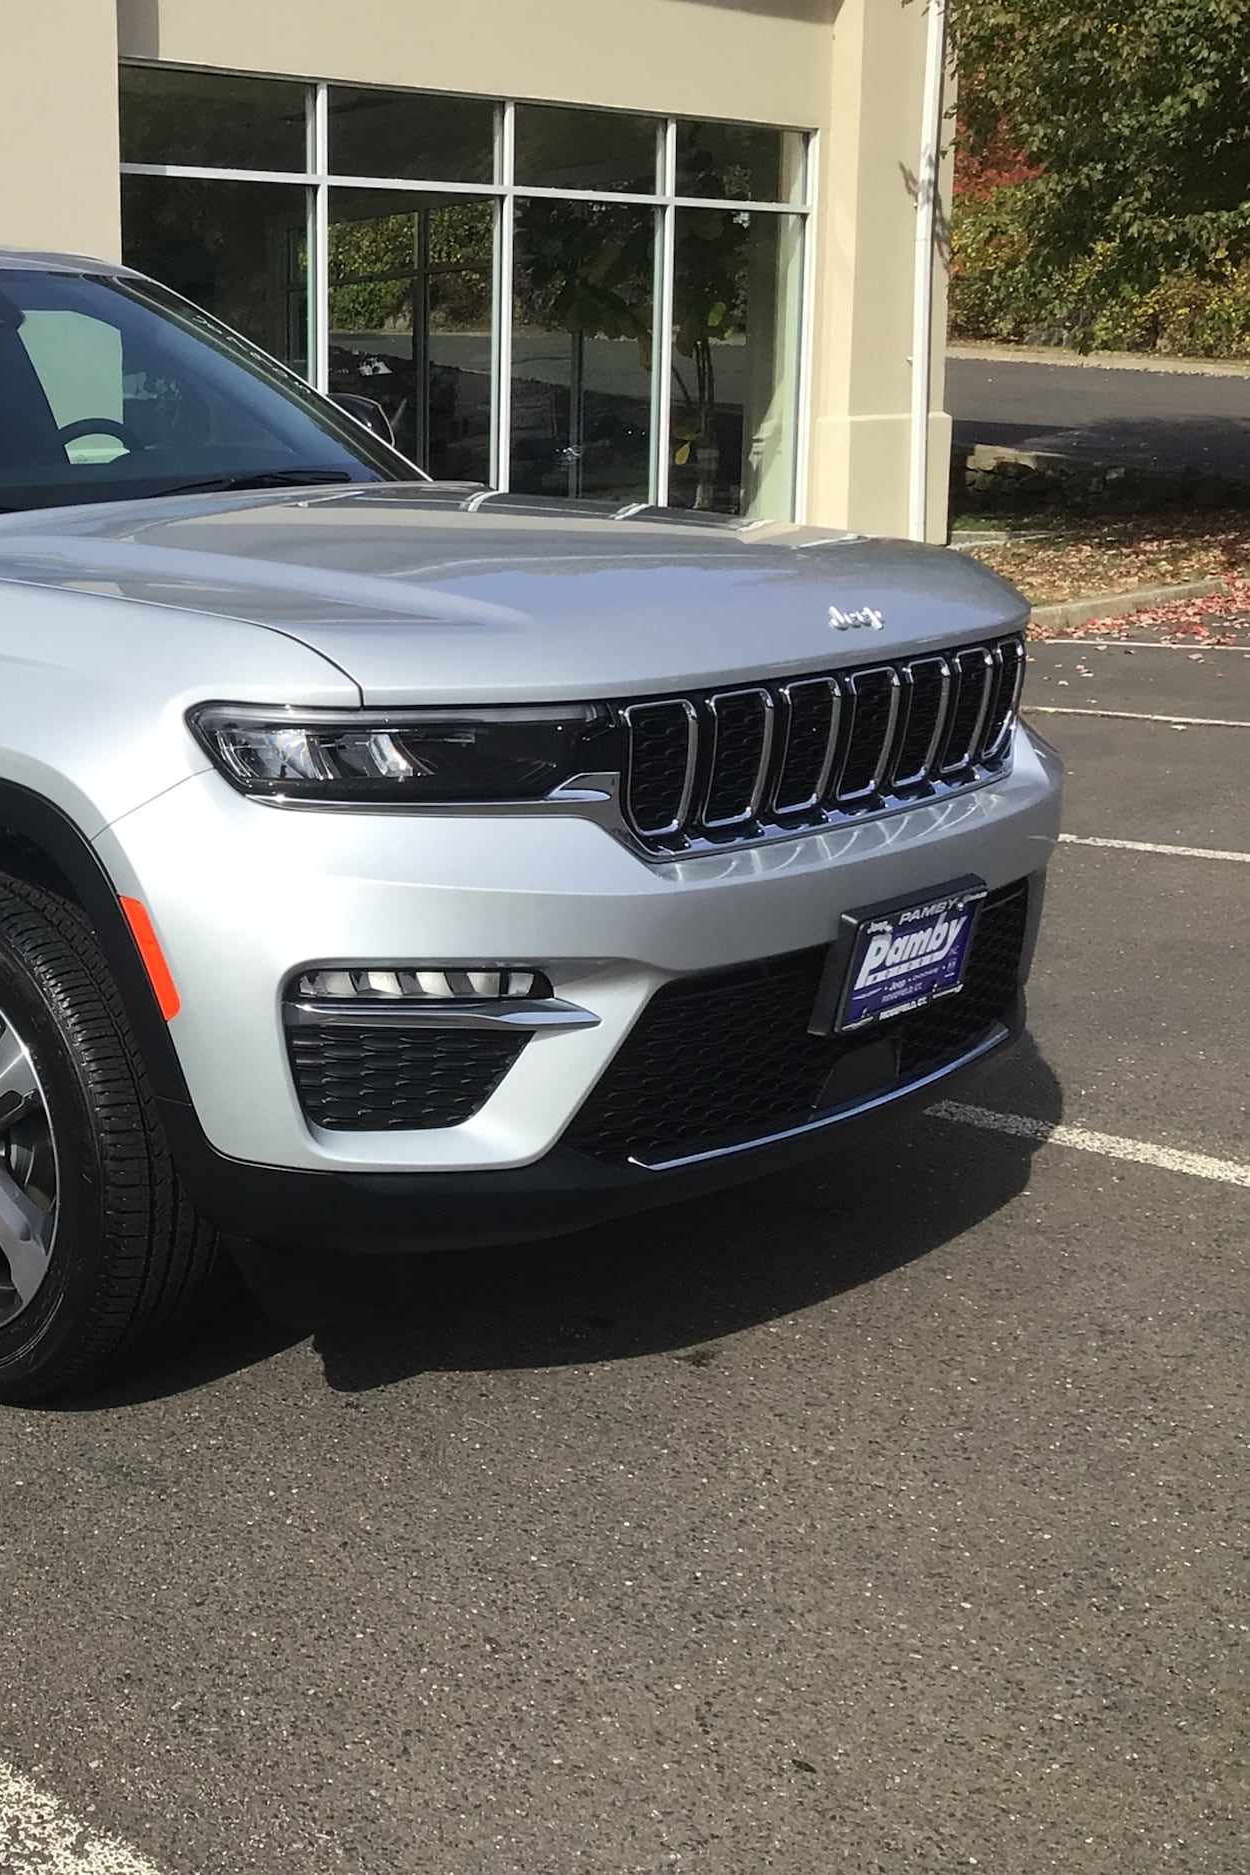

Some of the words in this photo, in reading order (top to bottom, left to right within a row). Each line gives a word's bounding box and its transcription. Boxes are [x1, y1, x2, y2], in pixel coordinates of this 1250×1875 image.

[829, 606, 885, 631] Jeep
[899, 898, 958, 925] PAMBY
[853, 912, 968, 991] Pamby
